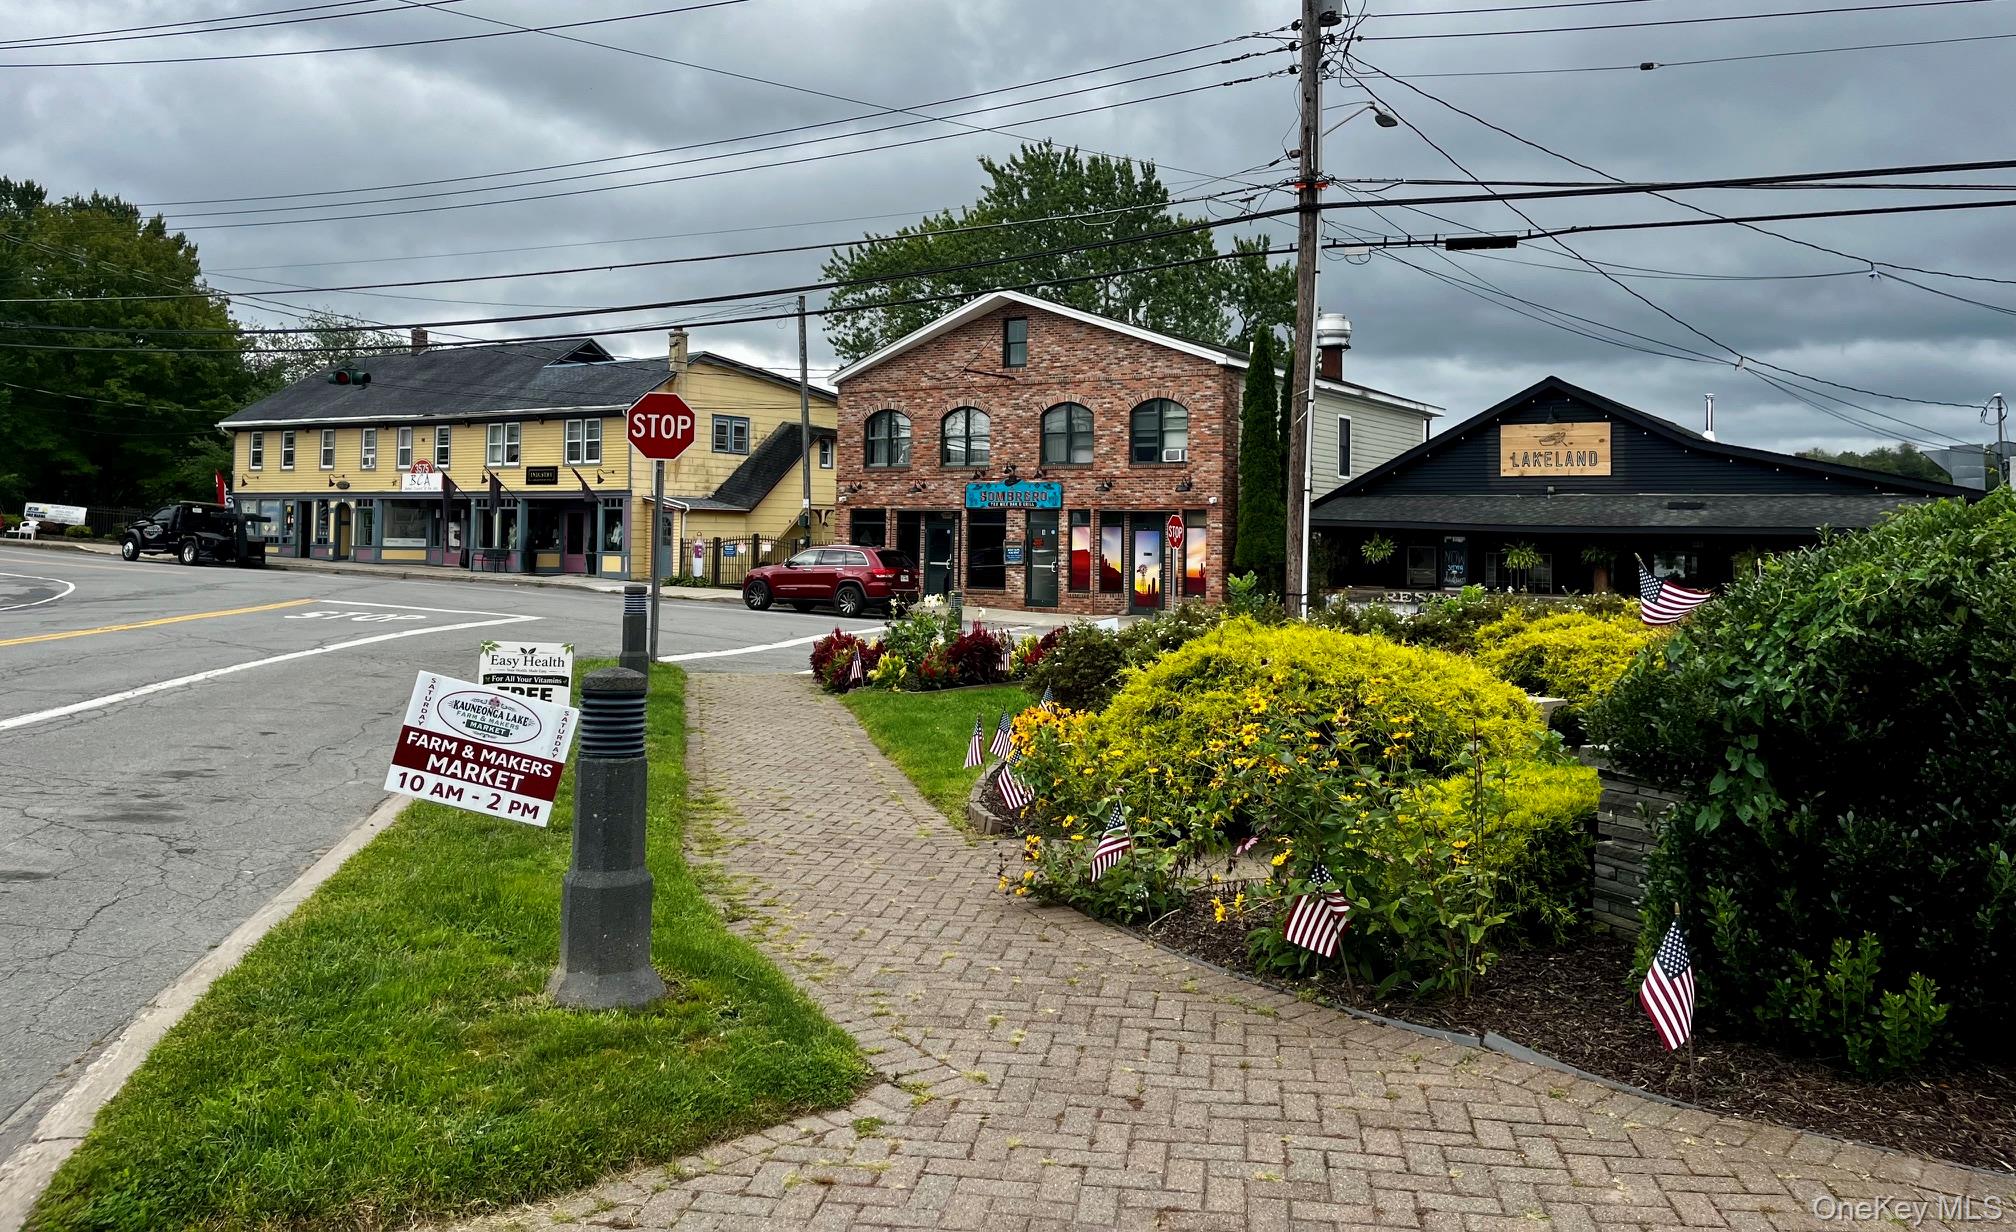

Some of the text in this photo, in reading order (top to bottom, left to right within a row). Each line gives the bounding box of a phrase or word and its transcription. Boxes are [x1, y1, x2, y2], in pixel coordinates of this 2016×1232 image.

[632, 413, 692, 439] STOP
[1511, 450, 1598, 468] LAKELAND
[414, 463, 430, 473] 3575
[409, 474, 431, 486] BCA
[980, 490, 1049, 502] SOMBRERO
[1168, 525, 1183, 539] STOP
[284, 611, 427, 623] STOP
[490, 654, 565, 669] Easy Health
[491, 675, 562, 684] For All Your Vitamins
[418, 677, 436, 726] SATURDAY
[497, 686, 553, 703] REE
[453, 699, 529, 727] KAUNEONGA LAKE
[456, 711, 478, 720] FARM
[488, 718, 520, 731] MAKERS
[469, 721, 507, 736] MARKET
[552, 710, 569, 758] SATURDAY
[406, 731, 553, 778] FARM & MAKERS
[426, 753, 525, 791] MARKET
[398, 771, 425, 792] 10
[429, 782, 465, 802] AM
[486, 792, 502, 811] 2
[507, 800, 540, 820] PM
